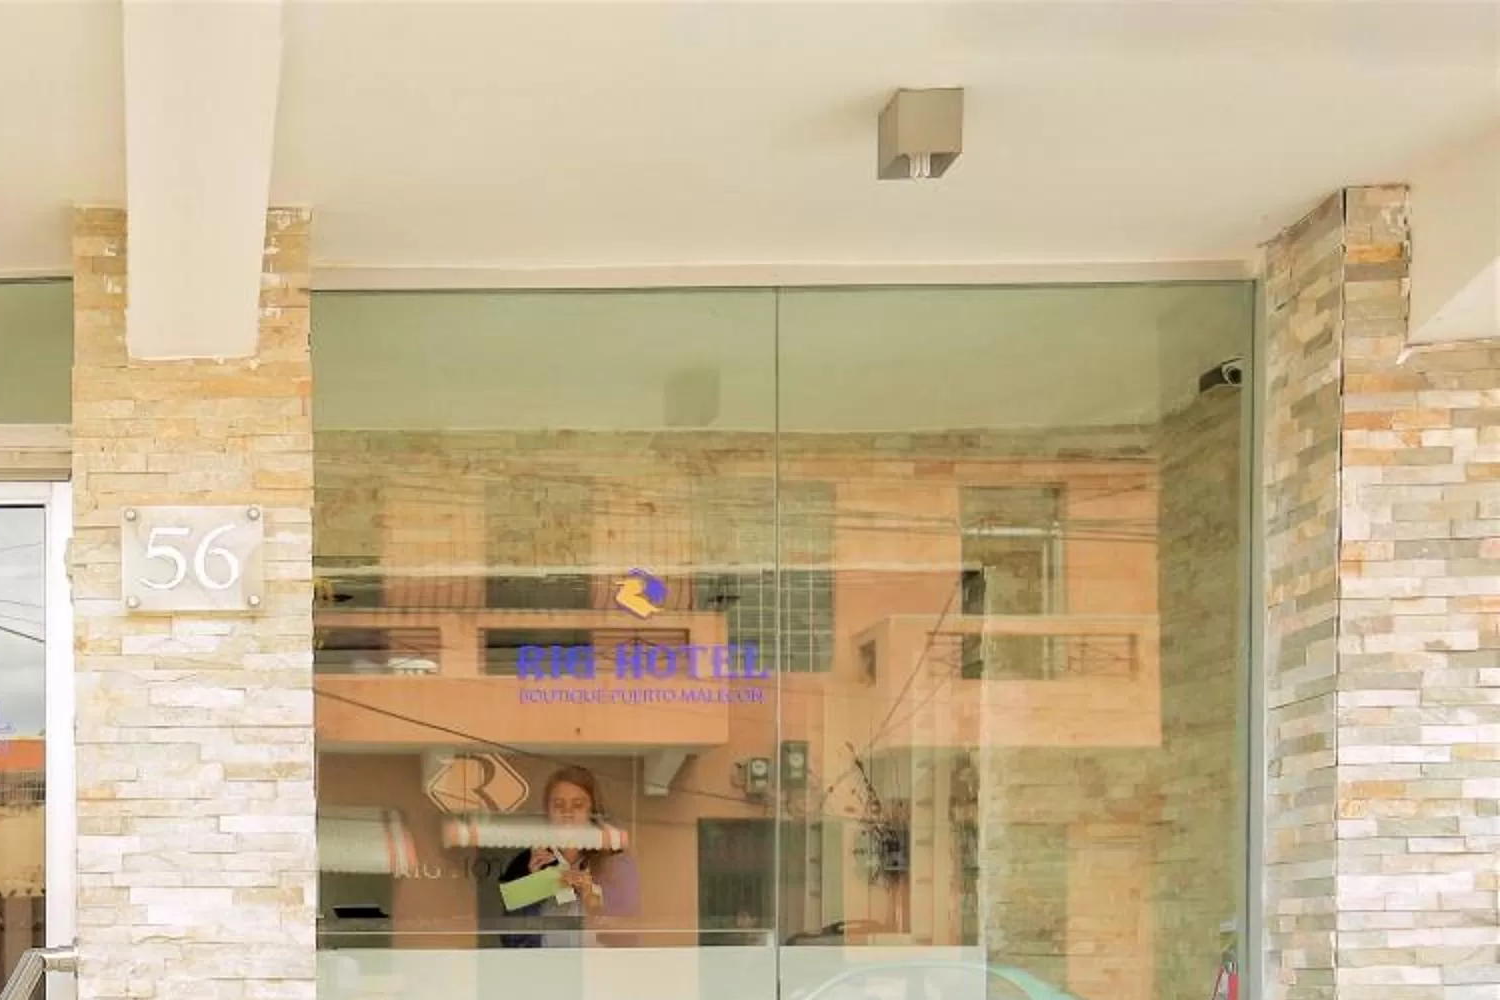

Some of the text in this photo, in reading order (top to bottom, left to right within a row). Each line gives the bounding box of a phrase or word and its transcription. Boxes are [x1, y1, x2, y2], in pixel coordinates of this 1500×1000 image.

[140, 524, 239, 590] 56
[516, 643, 770, 679] RIG HOTEL
